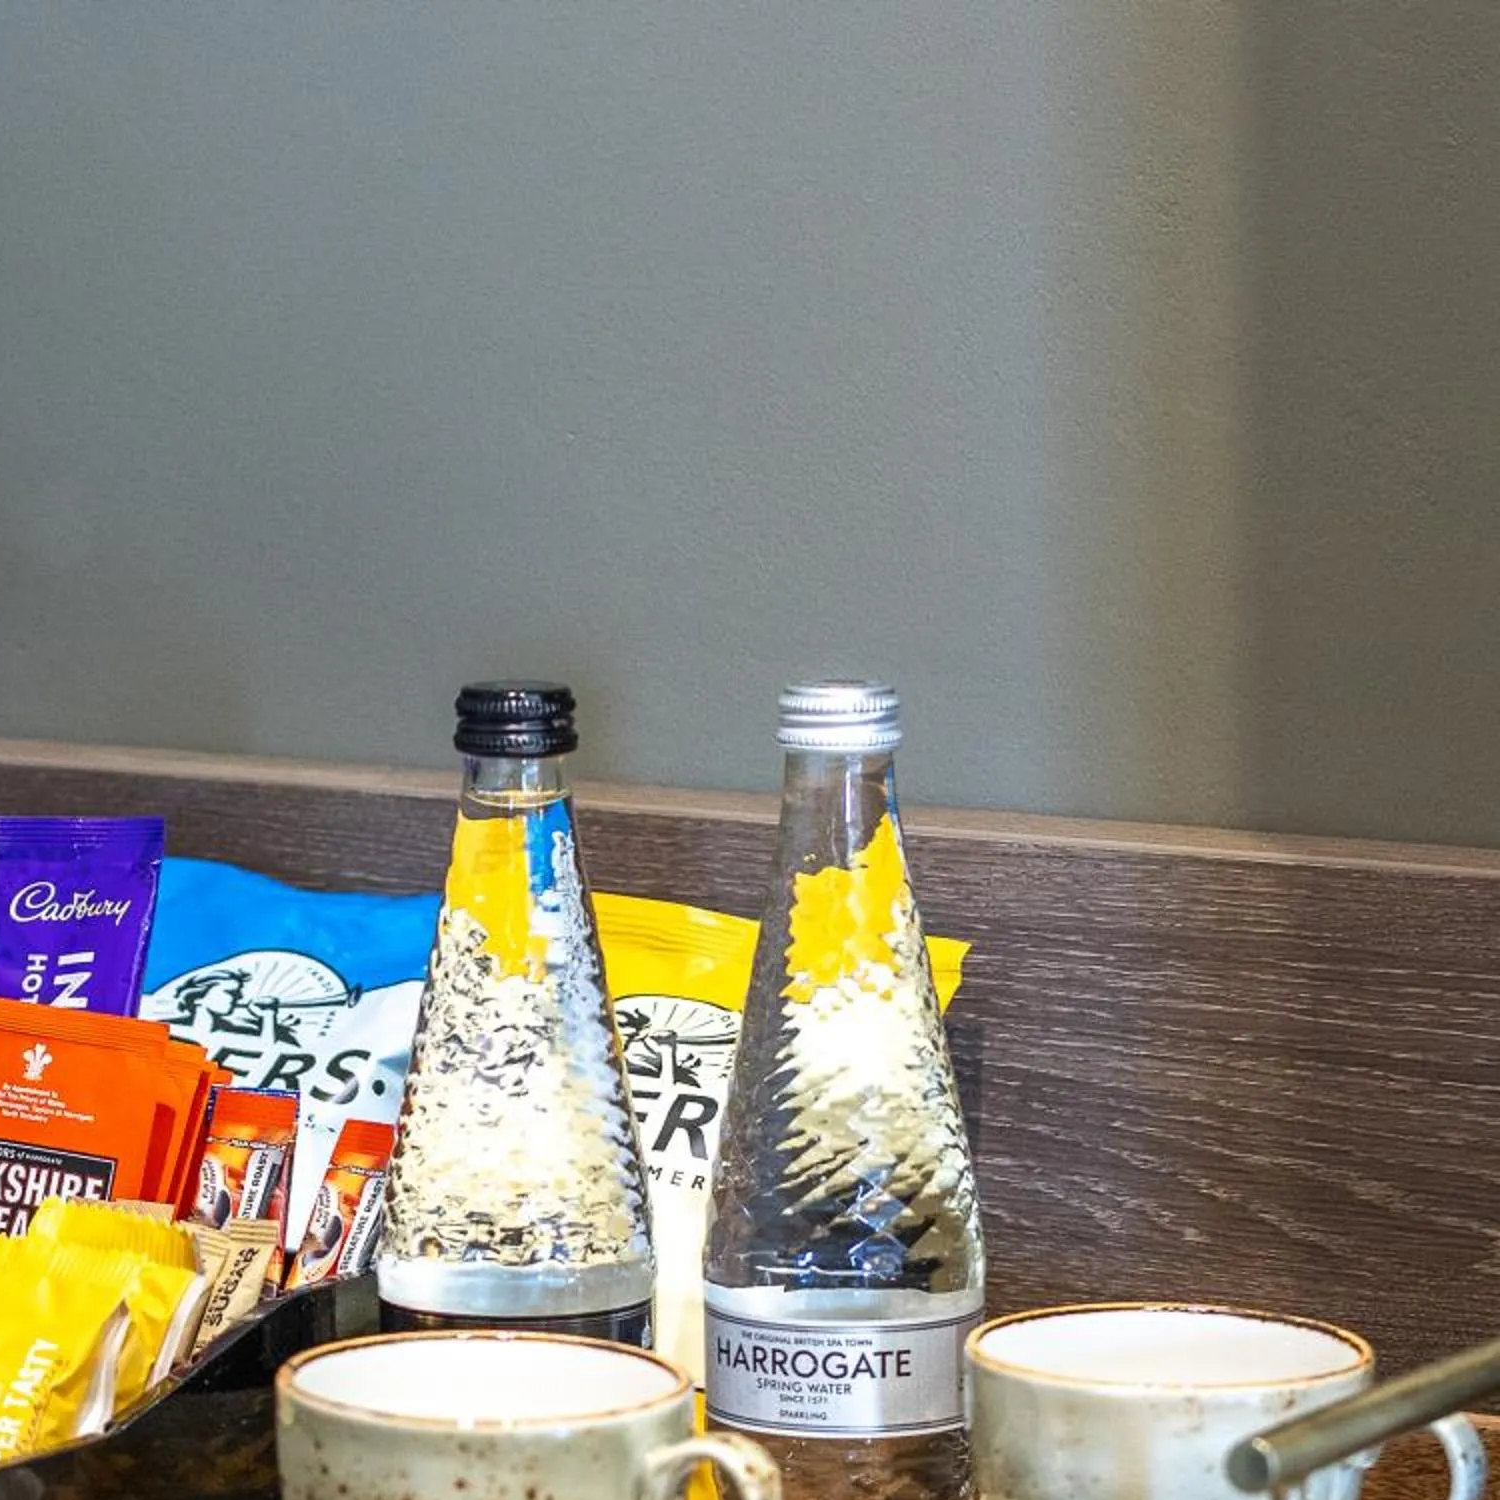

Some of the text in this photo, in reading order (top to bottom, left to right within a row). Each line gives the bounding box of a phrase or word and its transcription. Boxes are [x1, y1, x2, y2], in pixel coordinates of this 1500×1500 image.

[9, 881, 132, 926] Cadbury
[252, 1152, 270, 1187] ROAST
[364, 1178, 386, 1213] ROAST
[204, 1247, 260, 1326] SUGAR
[717, 1336, 912, 1379] HARROGATE
[845, 1338, 873, 1347] TOWN
[2, 1337, 60, 1409] TASTY
[756, 1377, 853, 1395] SPRING WATER
[778, 1409, 828, 1421] SPARKLING
[779, 1394, 805, 1404] SINCE
